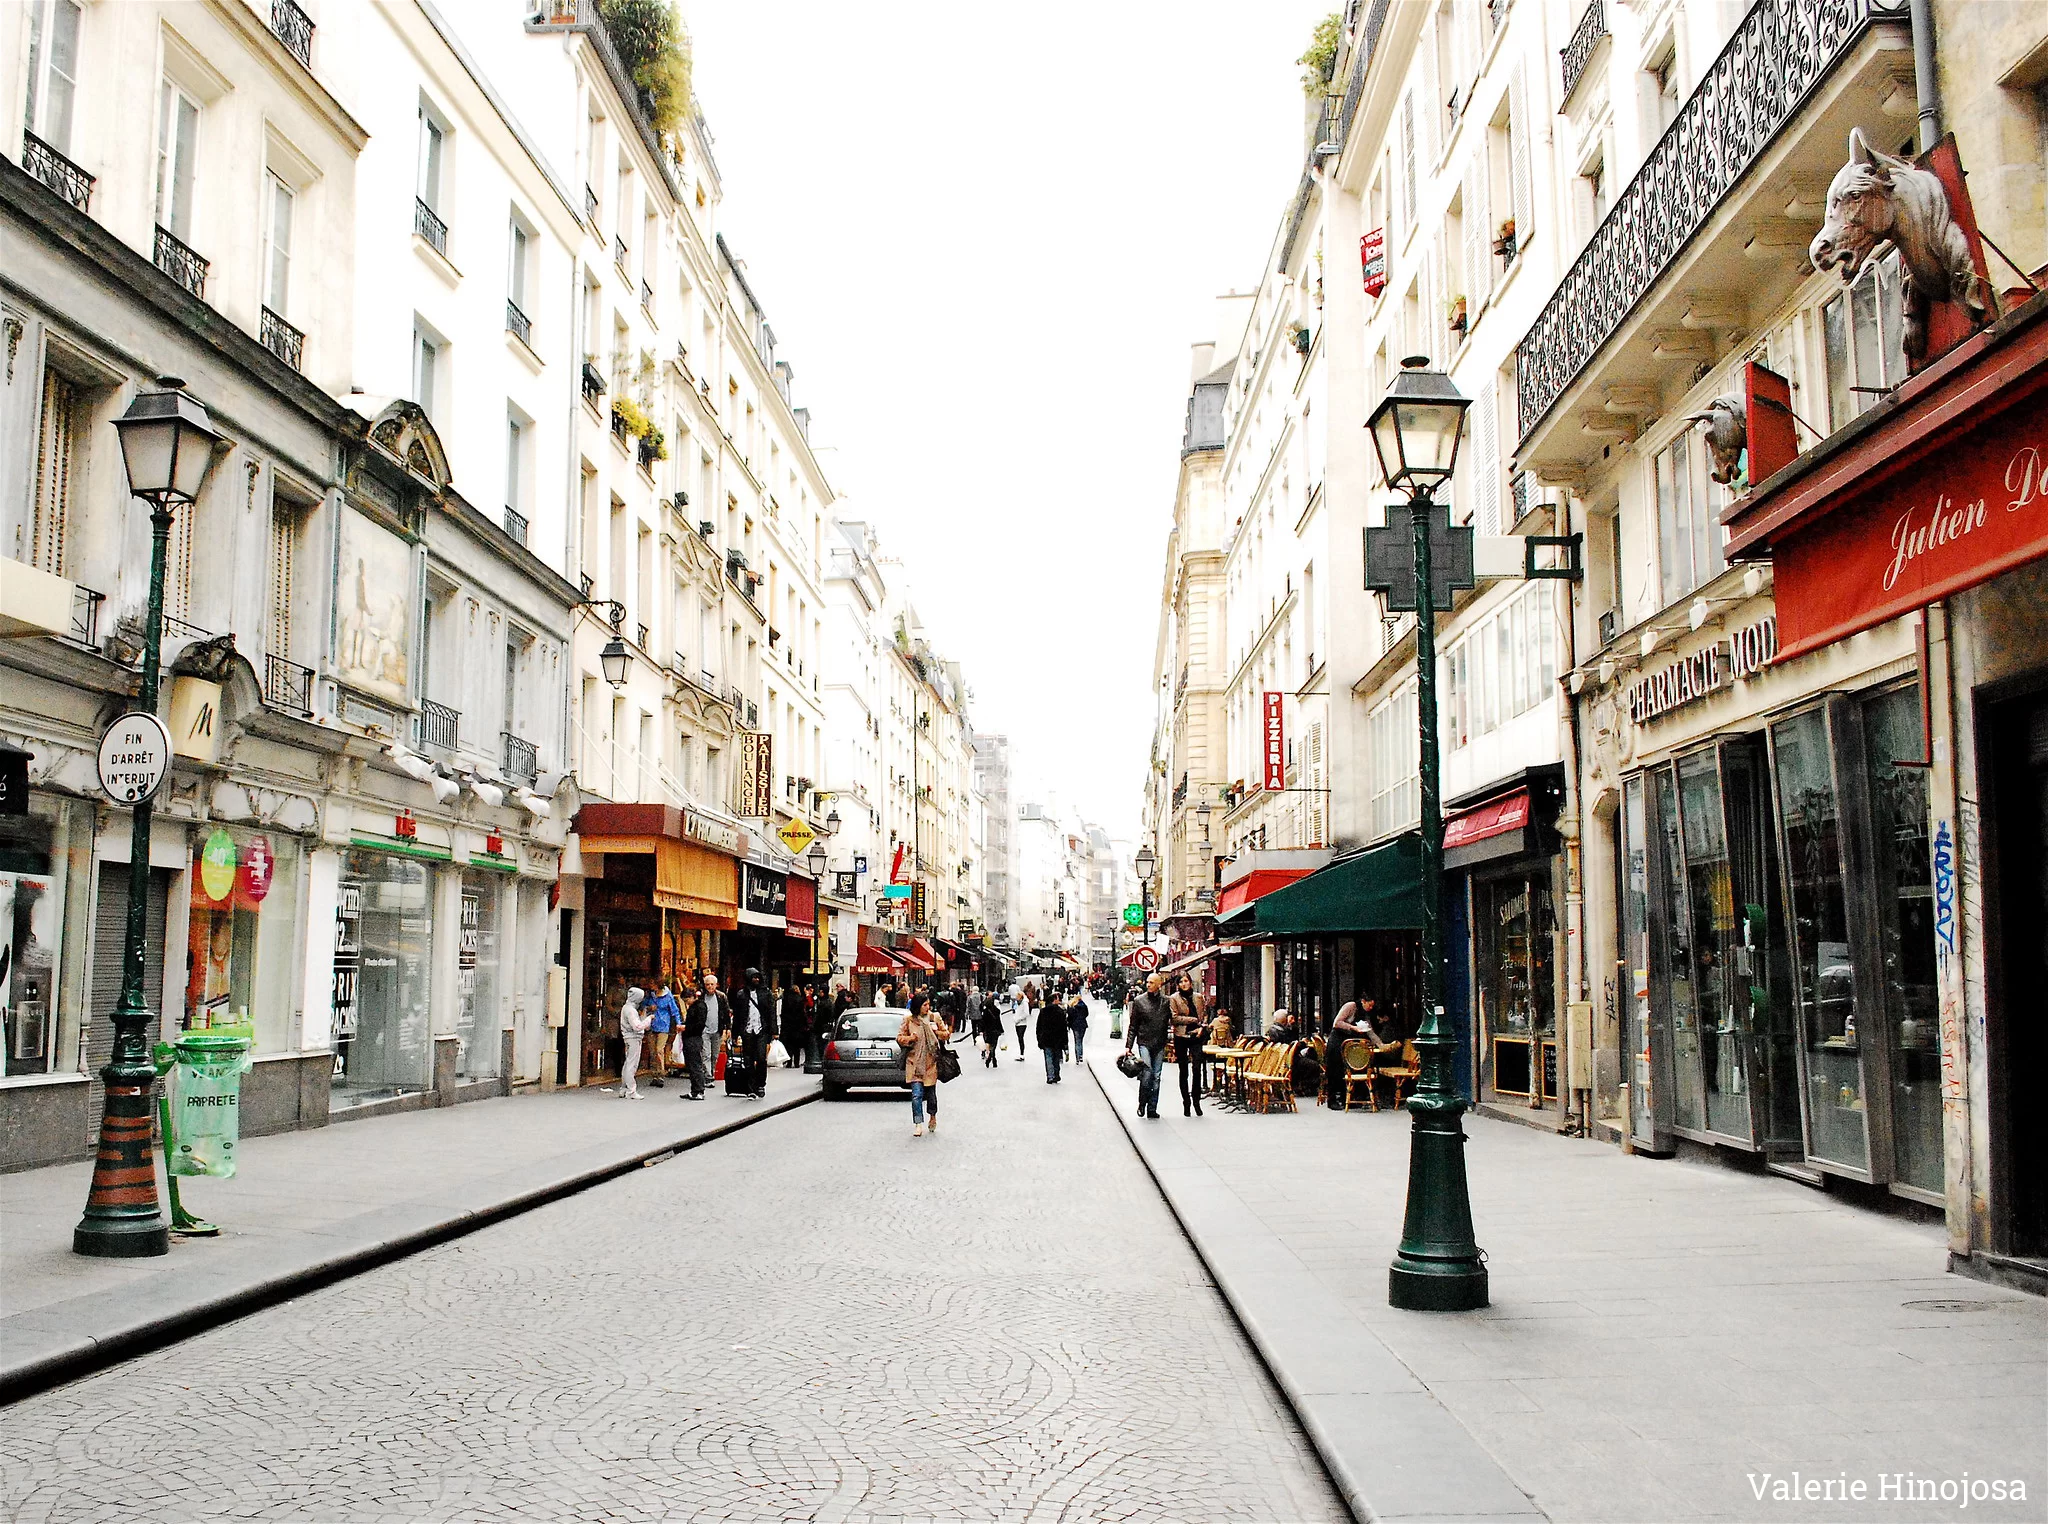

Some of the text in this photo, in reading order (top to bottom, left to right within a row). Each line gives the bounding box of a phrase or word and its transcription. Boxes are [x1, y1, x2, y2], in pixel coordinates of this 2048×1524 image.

[1883, 494, 1988, 591] Julien
[1628, 643, 1720, 723] PHARMACIE
[107, 773, 155, 784] INTERDIT
[111, 751, 153, 764] D'ARRÊT
[125, 734, 142, 744] FIN
[743, 736, 754, 814] BOULANGER
[757, 735, 770, 815] PATISSIER
[1268, 694, 1281, 788] PIZZERIA
